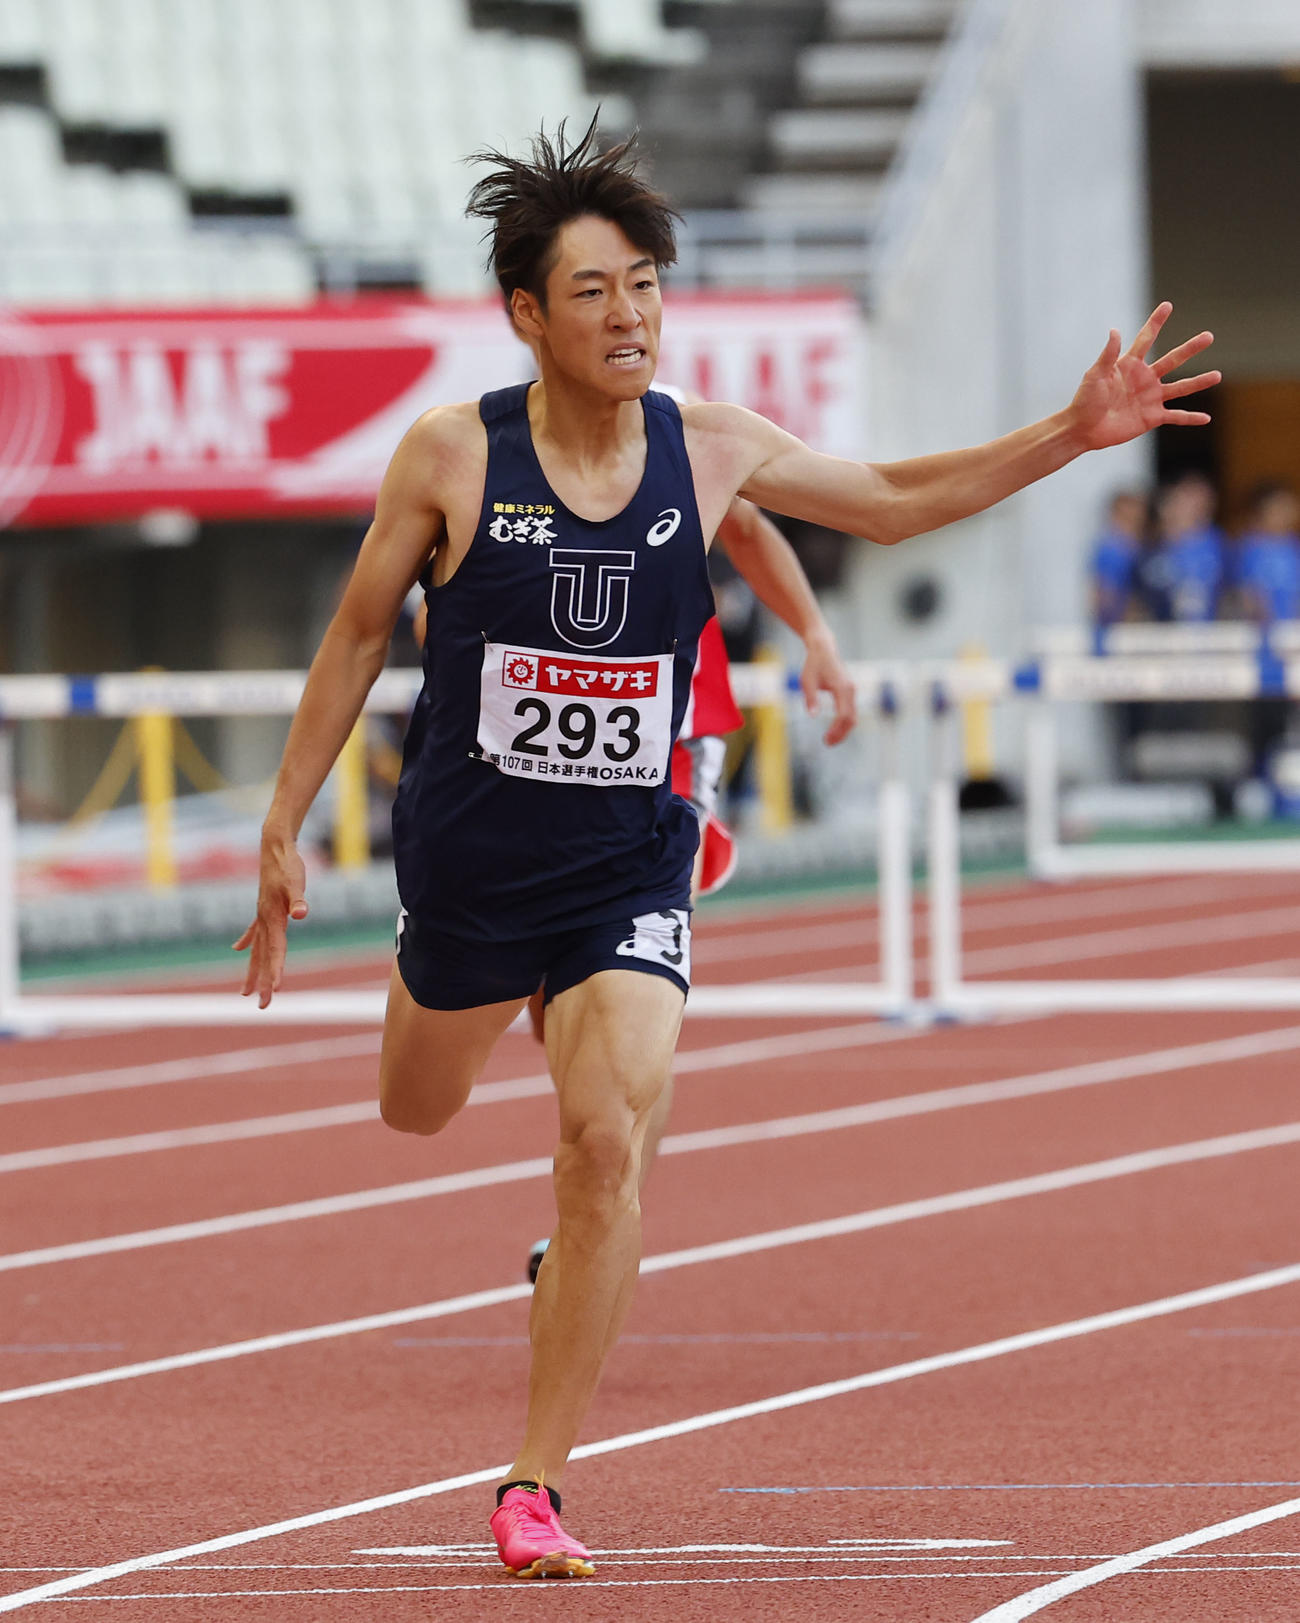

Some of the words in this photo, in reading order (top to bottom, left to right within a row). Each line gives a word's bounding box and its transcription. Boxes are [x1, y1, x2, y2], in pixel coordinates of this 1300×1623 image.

[74, 338, 292, 476] JAAF
[493, 502, 556, 514] 健康ミネラル
[488, 515, 559, 546] むぎ茶
[545, 664, 652, 692] ヤマザキ
[511, 697, 641, 762] 293
